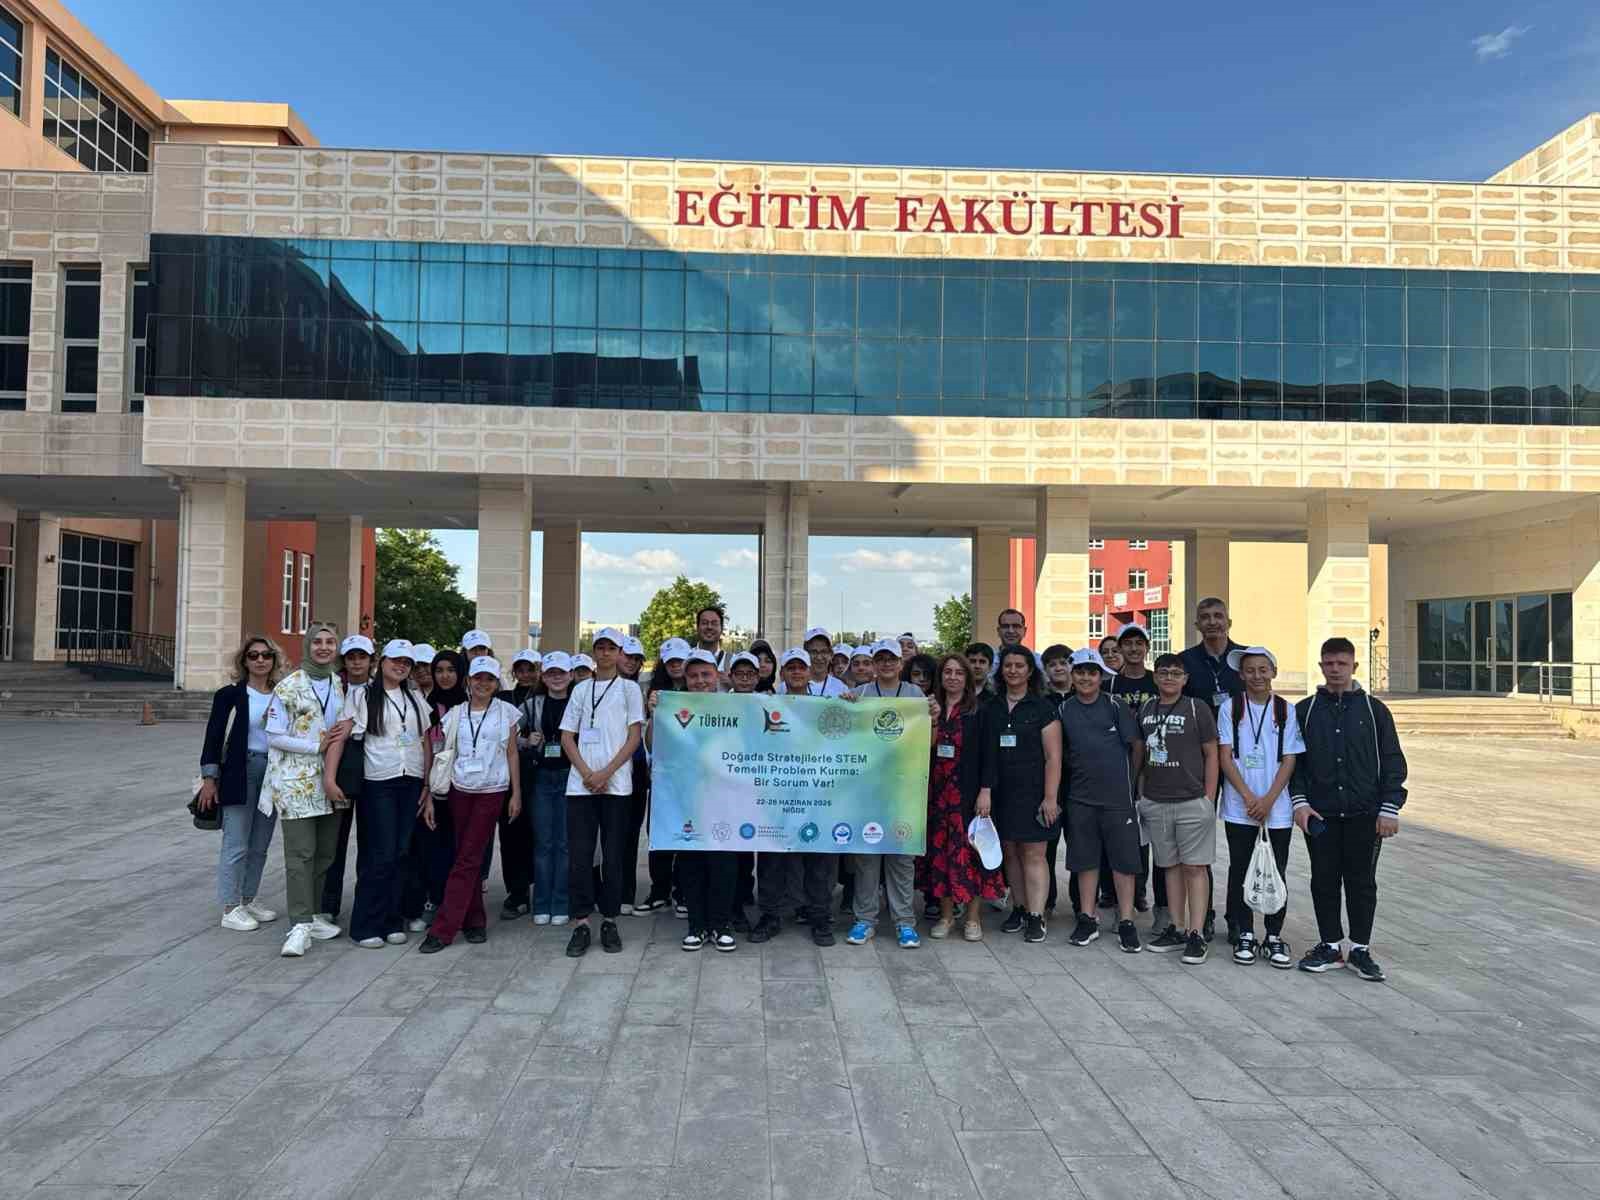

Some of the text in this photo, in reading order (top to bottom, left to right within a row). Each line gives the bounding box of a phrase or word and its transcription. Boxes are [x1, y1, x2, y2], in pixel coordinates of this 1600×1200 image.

[674, 183, 1185, 239] EĞİTİM FAKÜLTESİ
[699, 714, 738, 728] TÜBİTAK
[721, 751, 868, 764] Doğada Stratejilerle STEM
[728, 764, 859, 776] Temelli Problem Kurma:
[754, 777, 835, 788] Bir Sorum Var!
